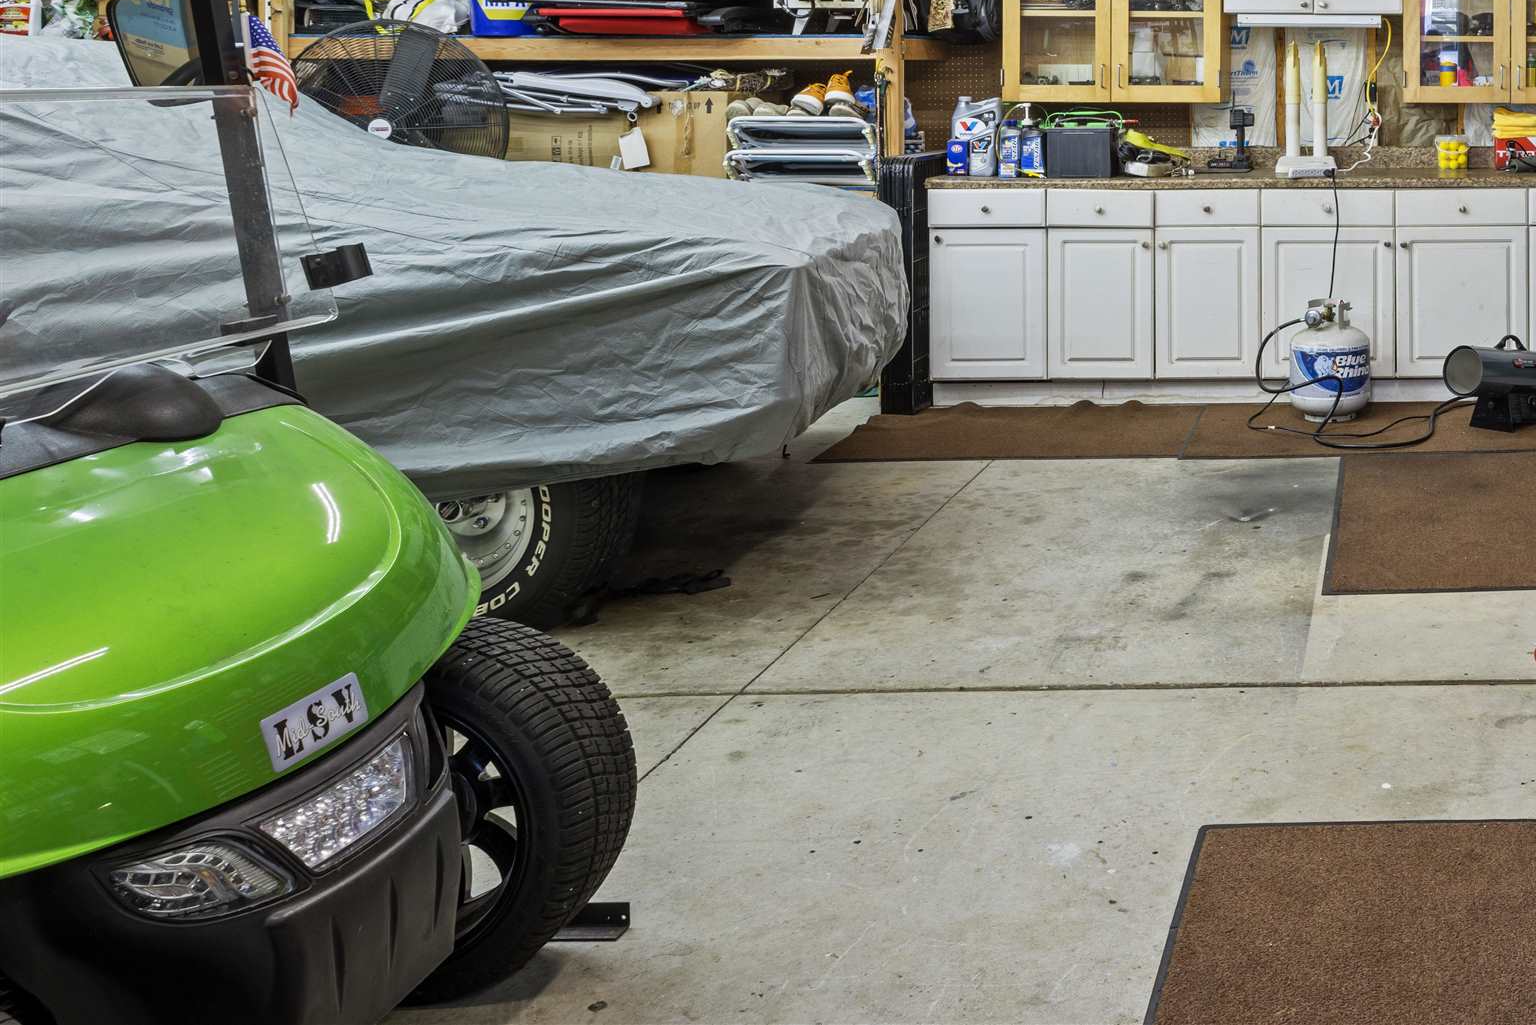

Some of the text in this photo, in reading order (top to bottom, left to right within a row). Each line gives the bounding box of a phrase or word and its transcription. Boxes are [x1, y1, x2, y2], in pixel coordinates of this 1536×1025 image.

[1335, 354, 1367, 367] Blue
[472, 484, 552, 617] OOPER COB
